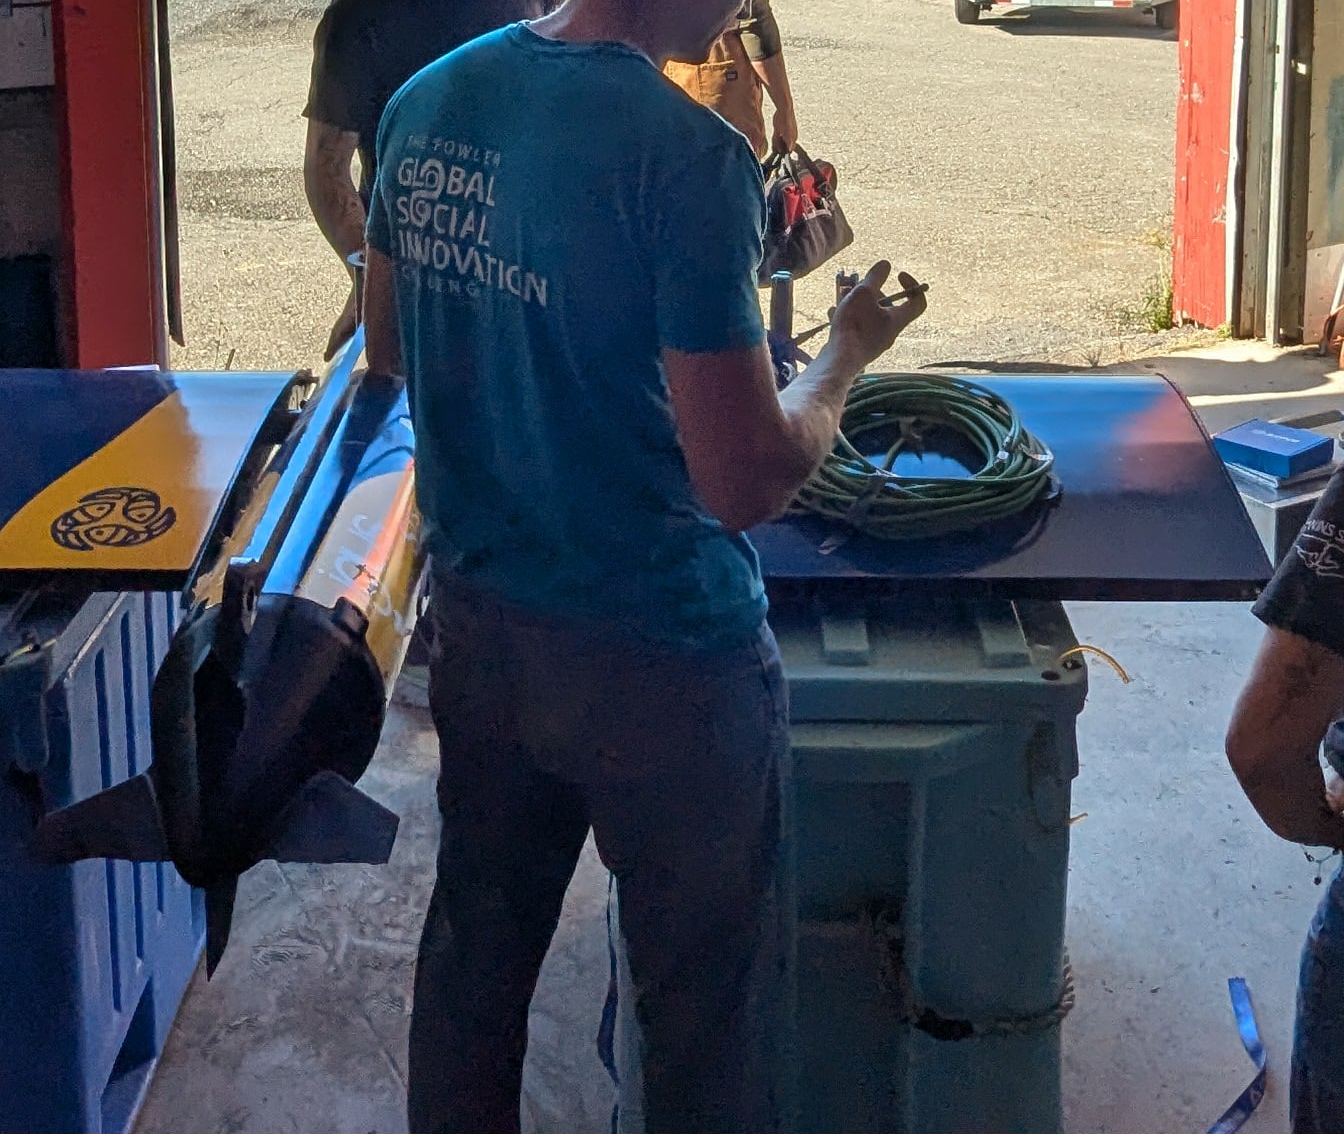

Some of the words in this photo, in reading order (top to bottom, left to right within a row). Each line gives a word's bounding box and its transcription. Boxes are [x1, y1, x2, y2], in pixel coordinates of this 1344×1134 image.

[397, 156, 495, 207] GLOBAL
[396, 191, 490, 247] SOCIAL
[398, 230, 547, 307] INNOVATION
